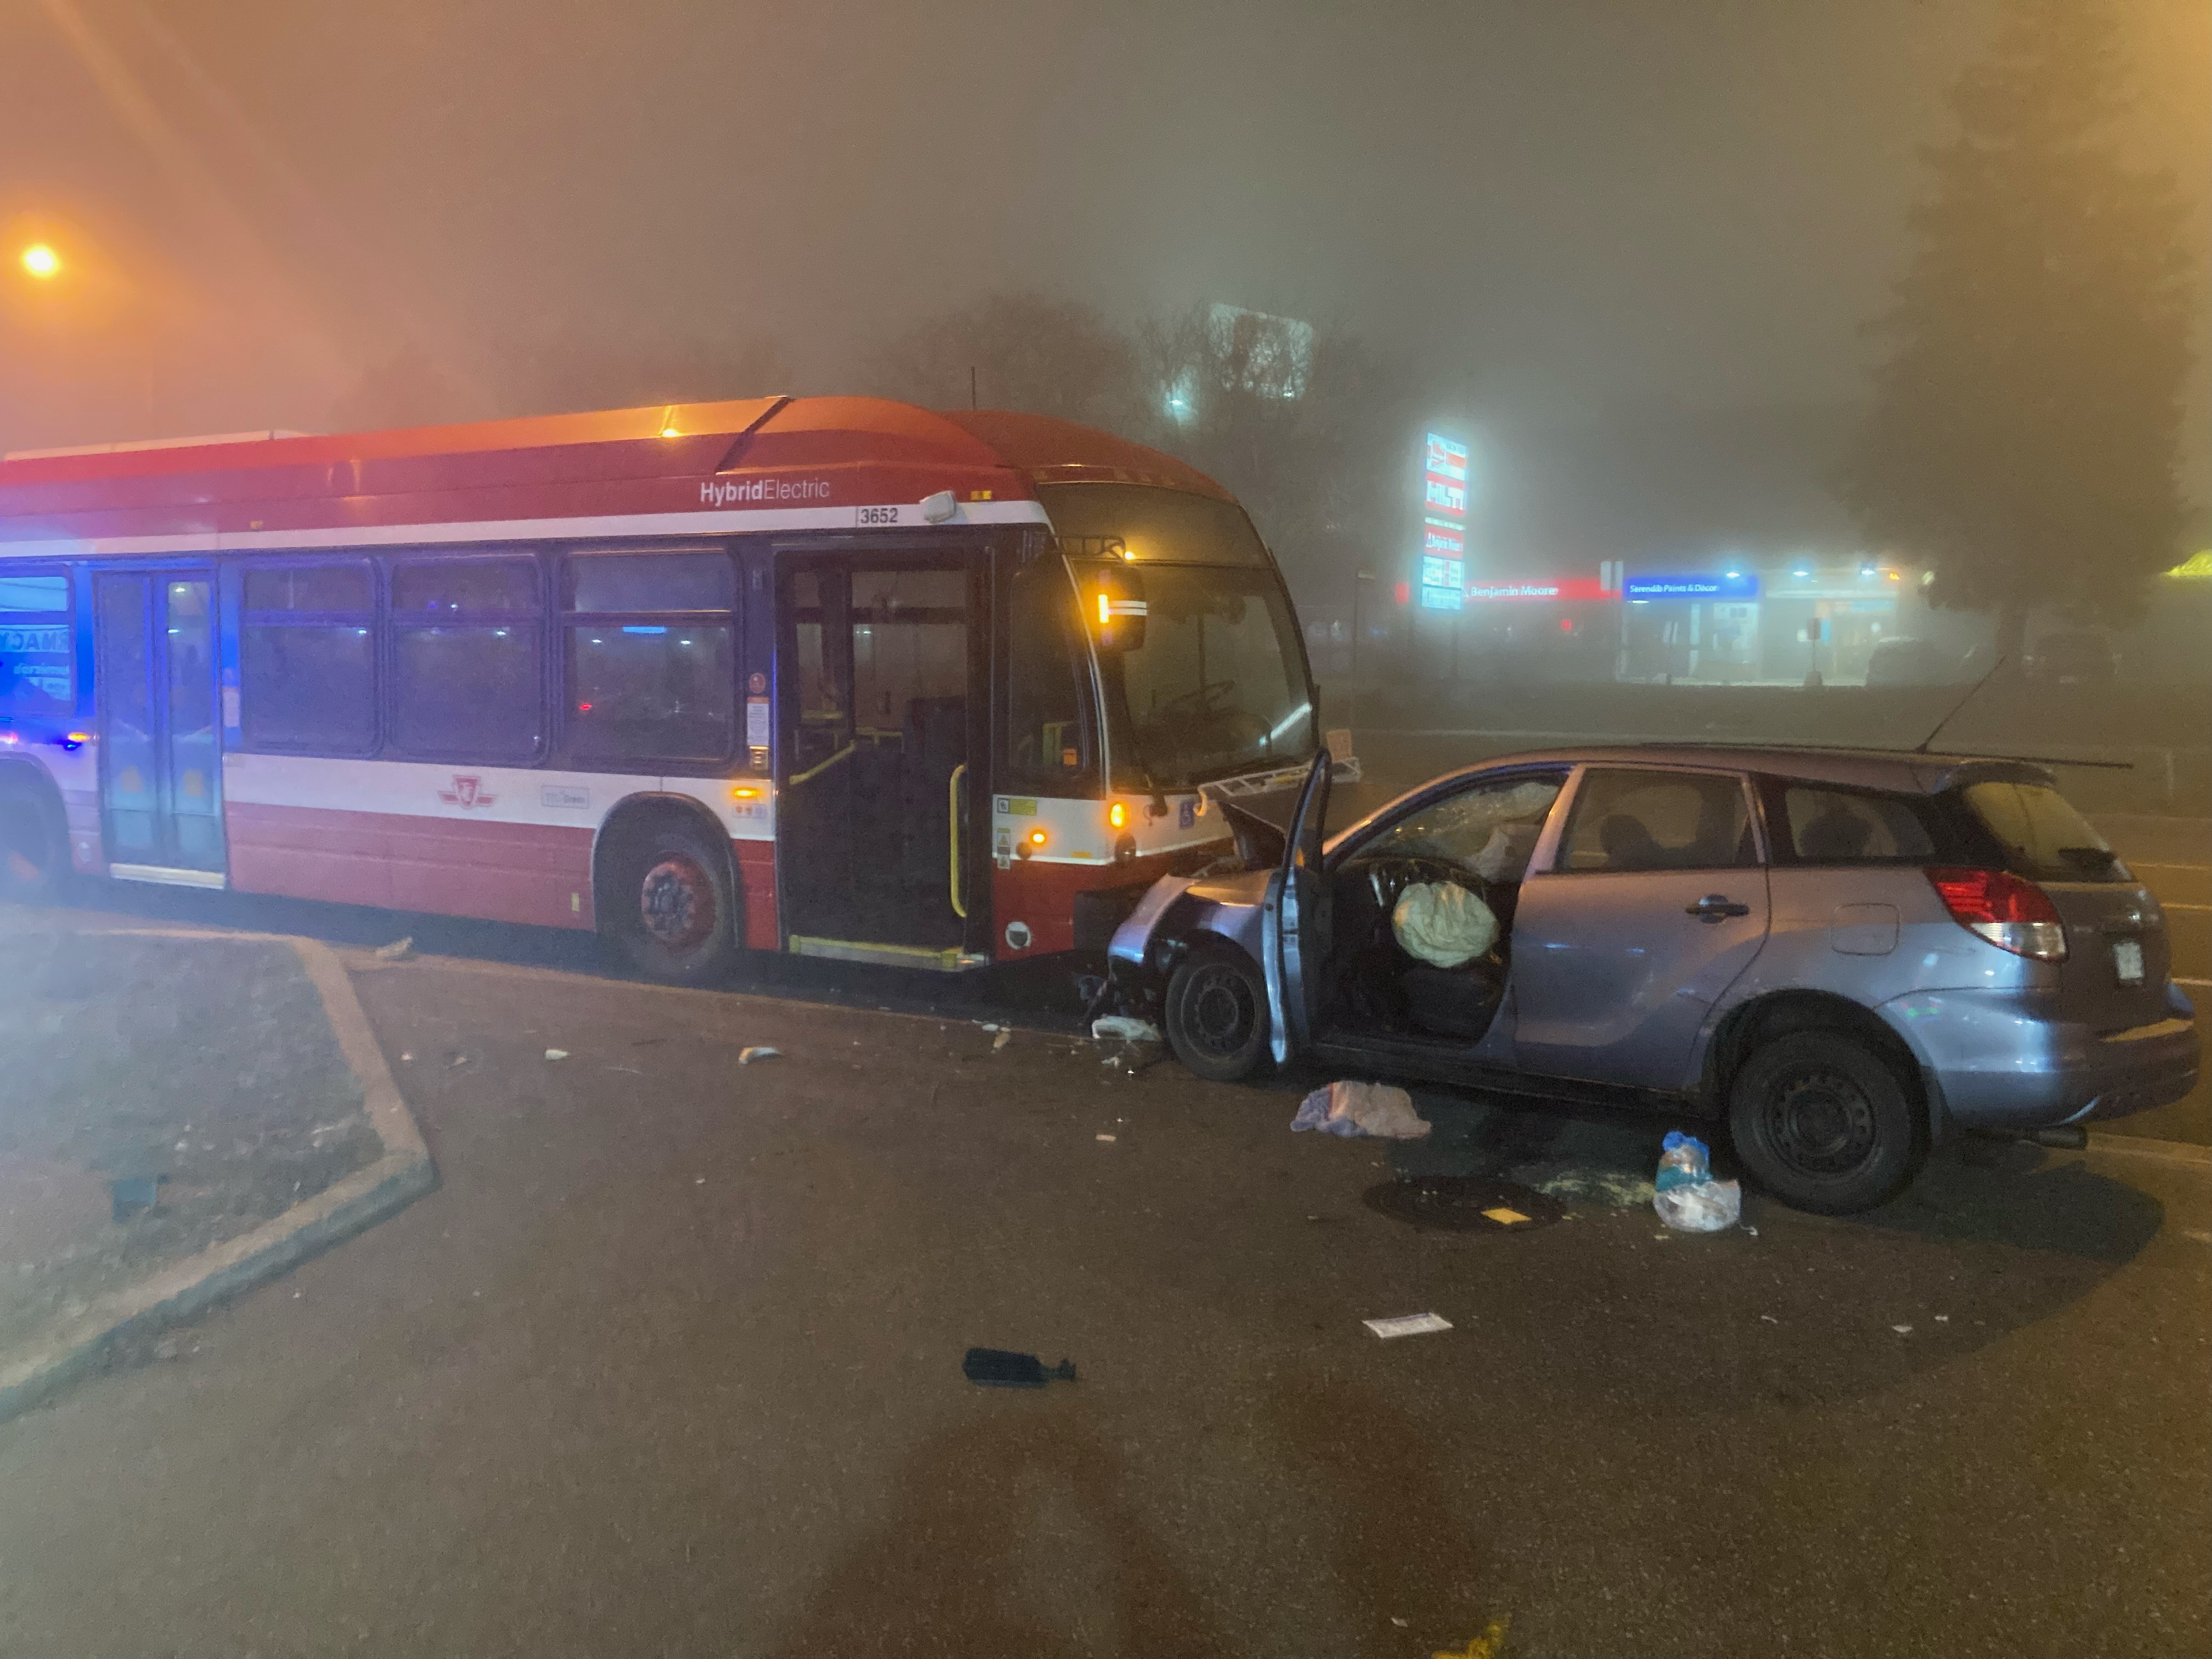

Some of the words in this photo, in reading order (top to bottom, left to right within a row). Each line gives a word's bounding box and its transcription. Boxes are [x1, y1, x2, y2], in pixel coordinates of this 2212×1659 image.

[700, 477, 830, 506] HybridElectric
[860, 507, 898, 524] 3652
[1470, 586, 1518, 599] Benjamin
[1521, 585, 1556, 595] Moore
[1687, 584, 1694, 592] &
